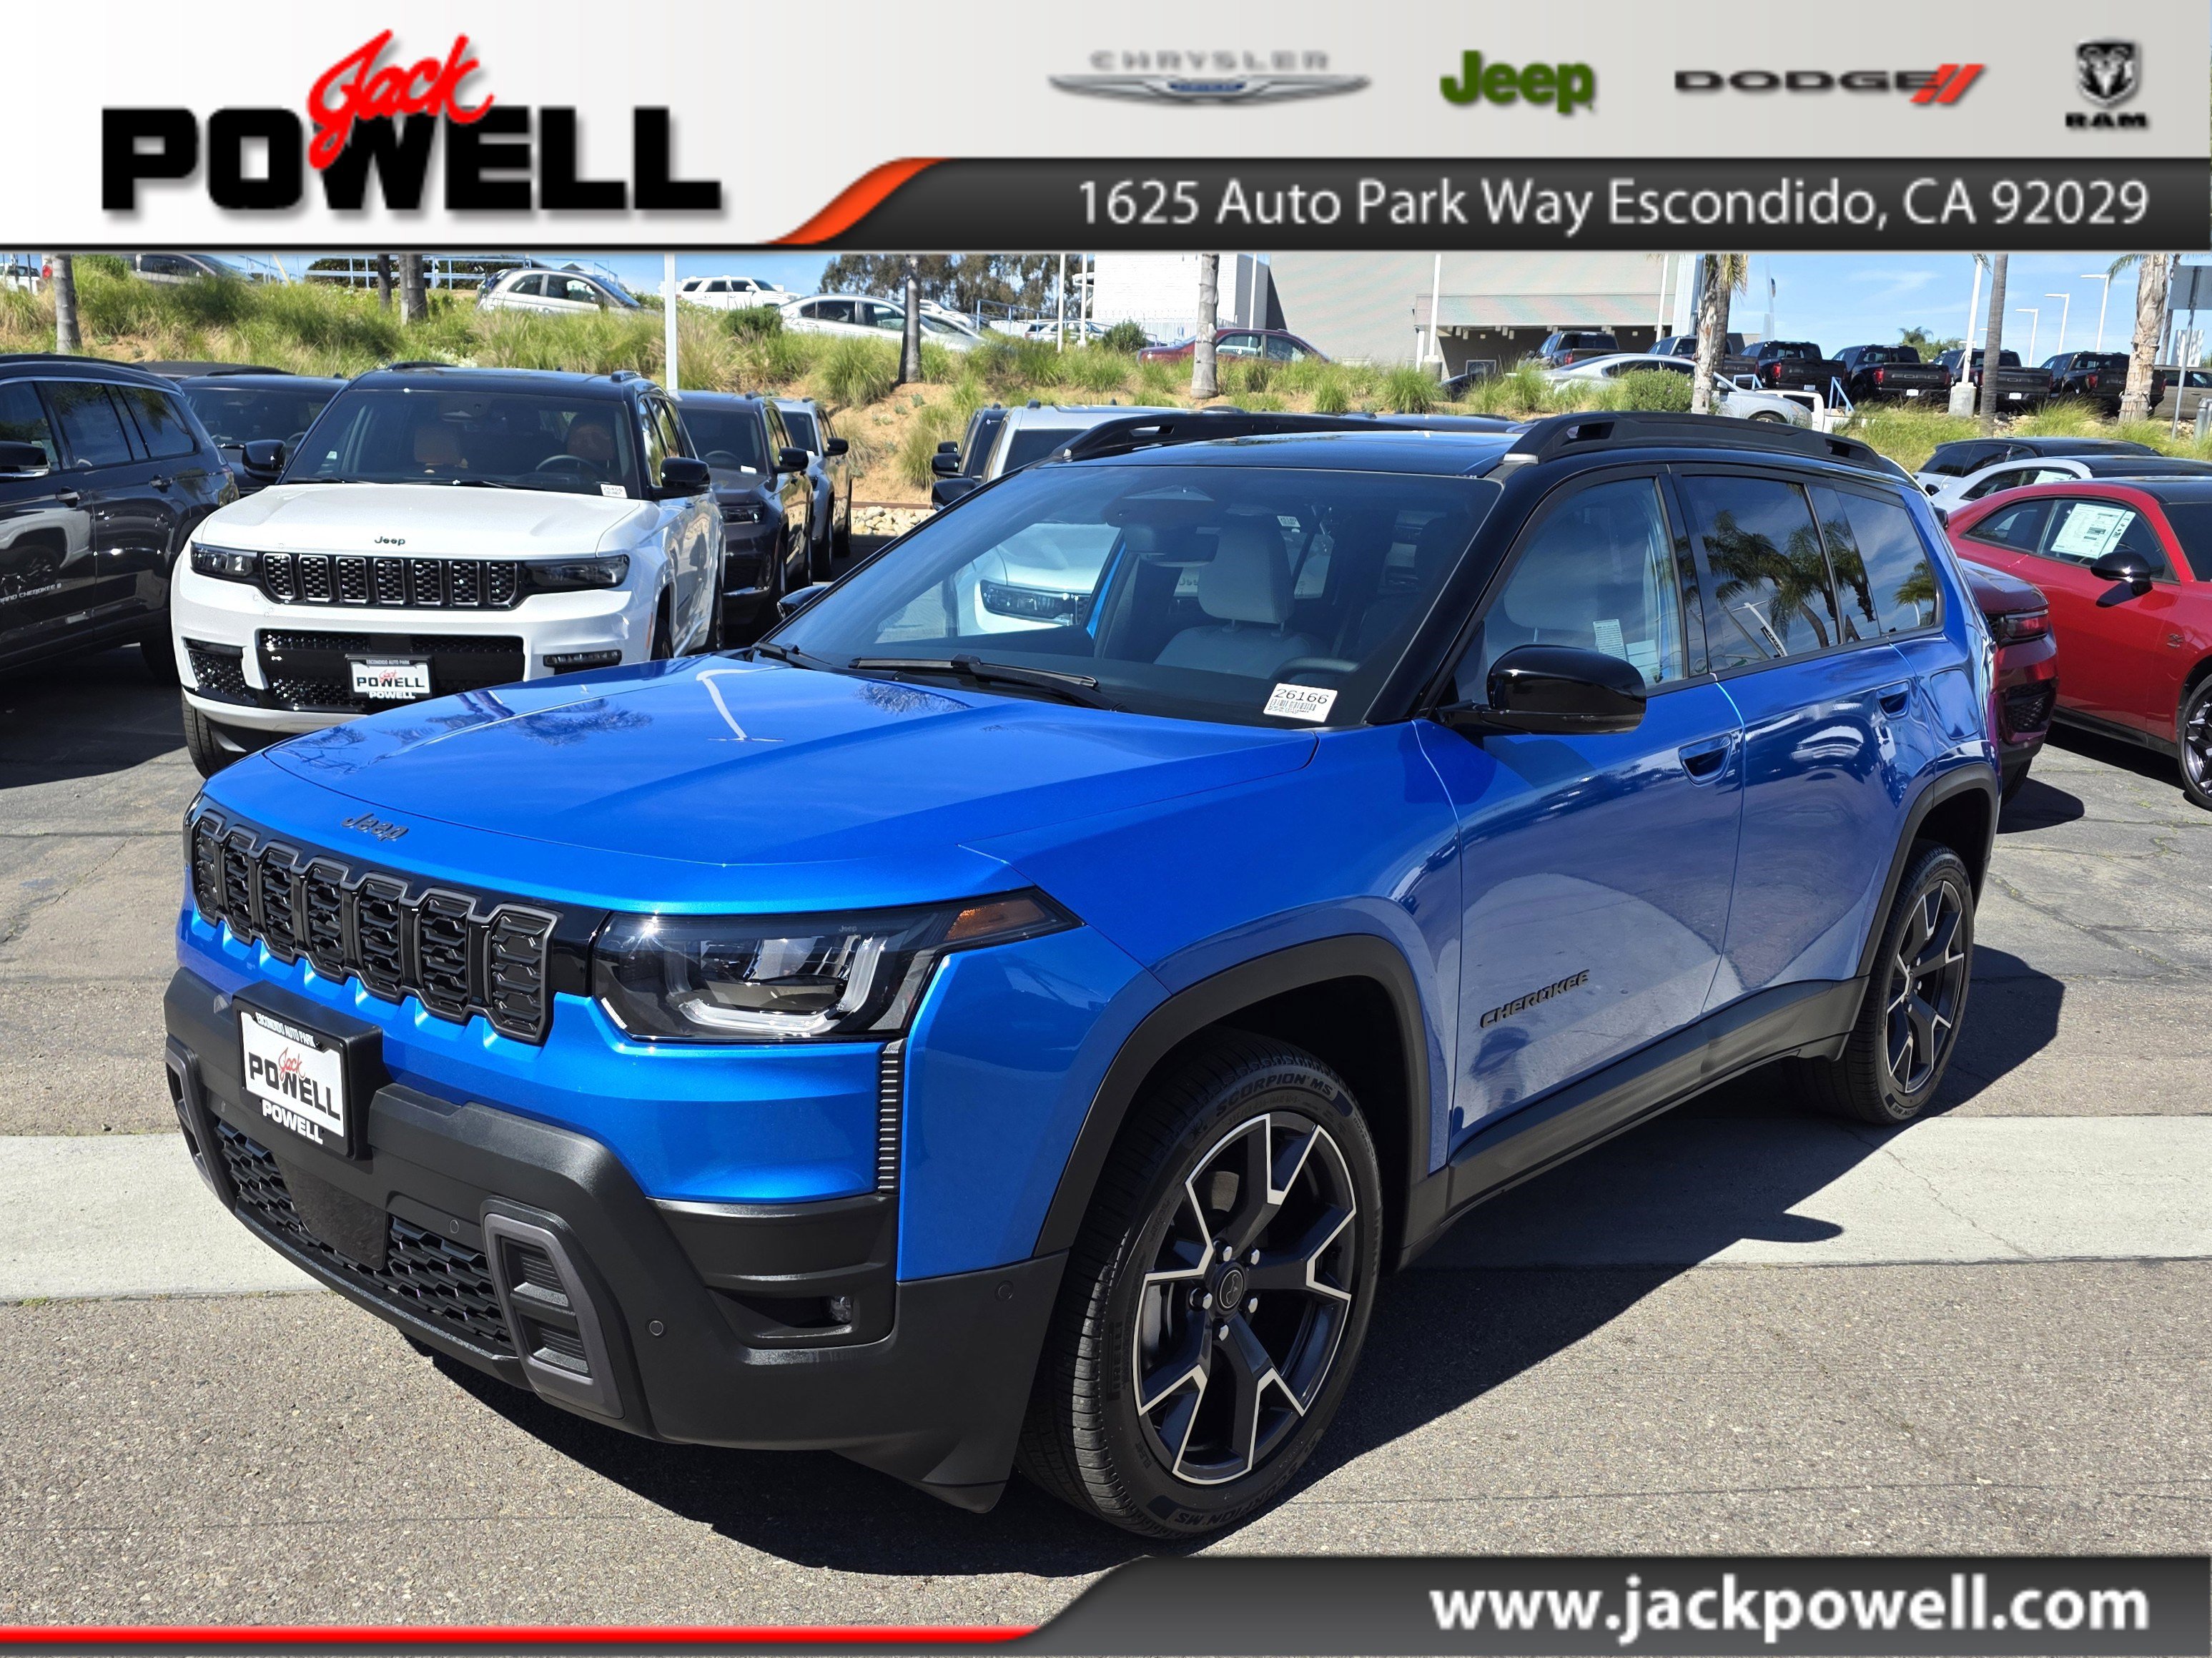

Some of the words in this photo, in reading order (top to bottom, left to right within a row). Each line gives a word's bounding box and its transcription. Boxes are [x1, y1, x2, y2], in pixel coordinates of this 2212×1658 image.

[374, 536, 406, 546] Jeep
[356, 676, 425, 688] POWELL
[368, 691, 416, 699] POWELL
[1273, 688, 1329, 704] 26166
[341, 812, 410, 842] Jeep
[1480, 969, 1590, 1029] CHEROKEE
[278, 1047, 306, 1081] Jack
[248, 1052, 341, 1122] POWELL
[1216, 1072, 1308, 1118] SCORPION
[1310, 1077, 1333, 1096] MS
[262, 1099, 323, 1145] POWELL
